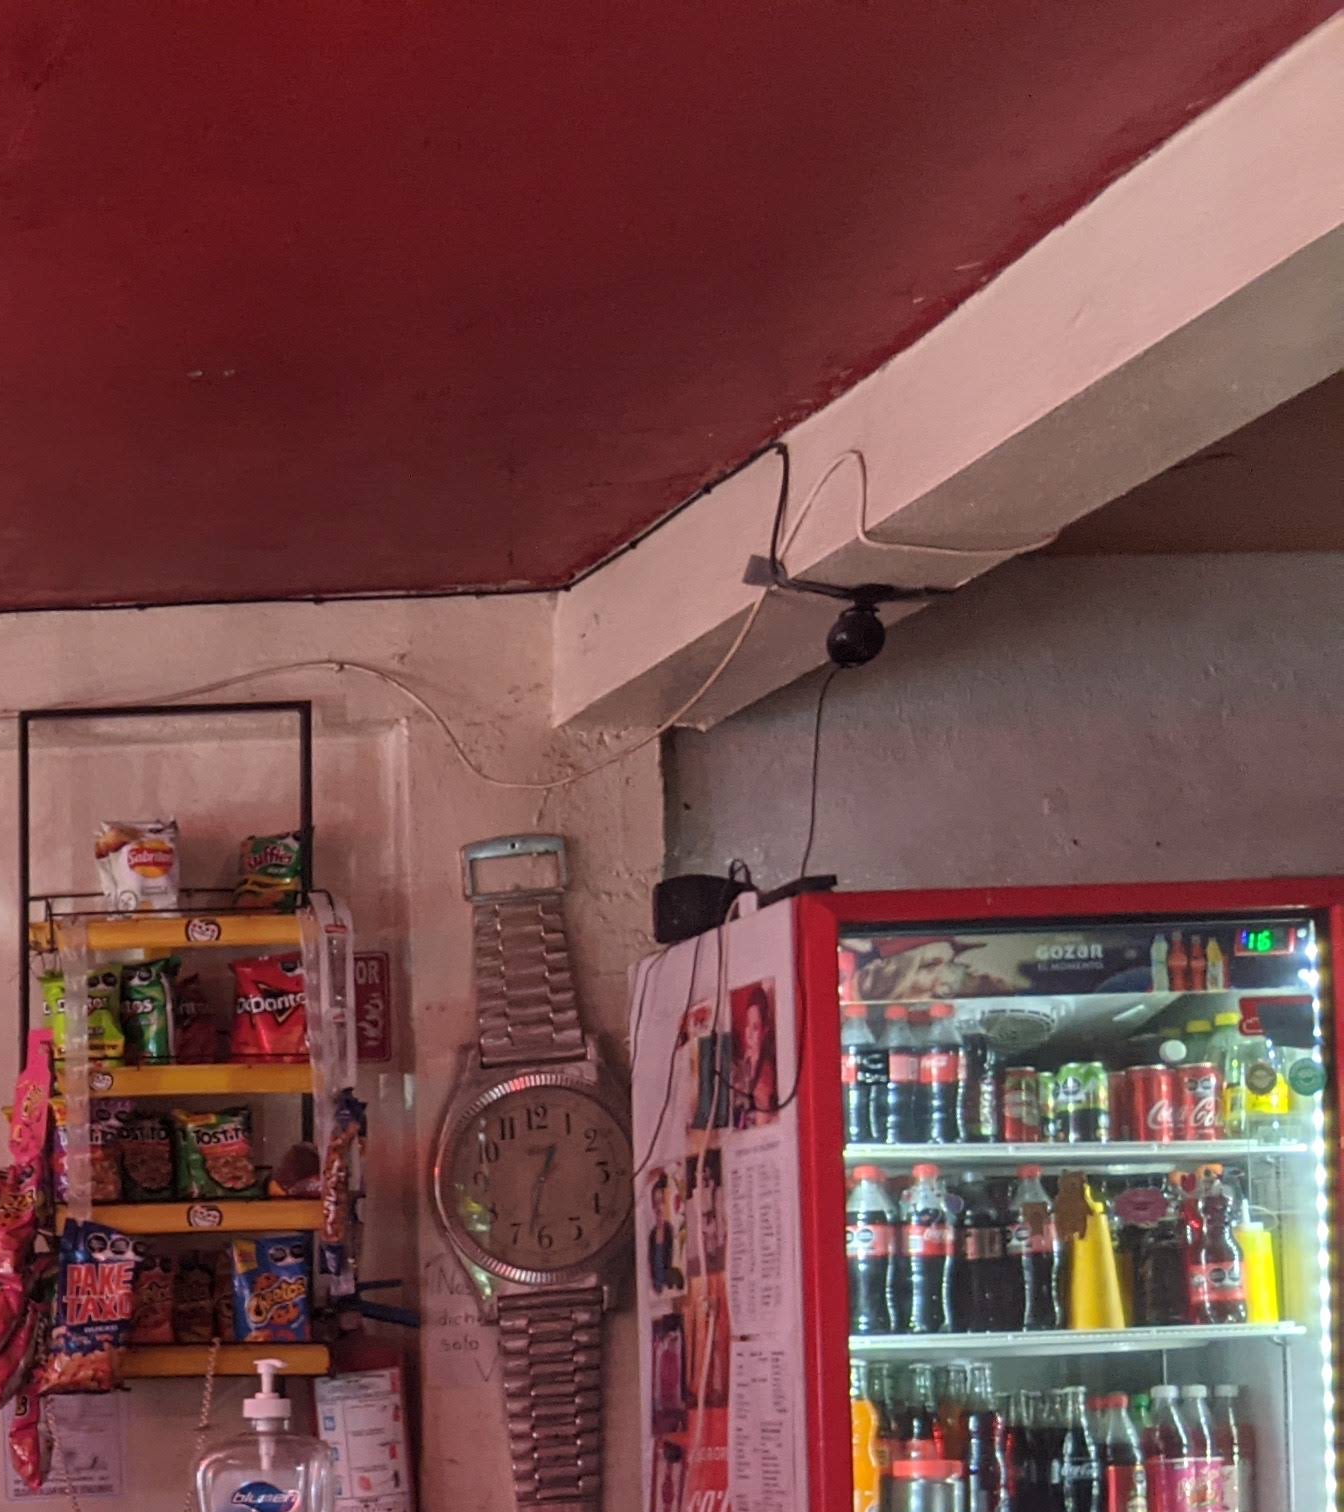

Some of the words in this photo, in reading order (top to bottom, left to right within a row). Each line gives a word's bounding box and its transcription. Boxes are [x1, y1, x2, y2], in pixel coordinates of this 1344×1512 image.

[499, 1117, 515, 1140] 11
[526, 1105, 548, 1129] 12
[585, 1128, 598, 1152] 2
[537, 1226, 553, 1249] 6
